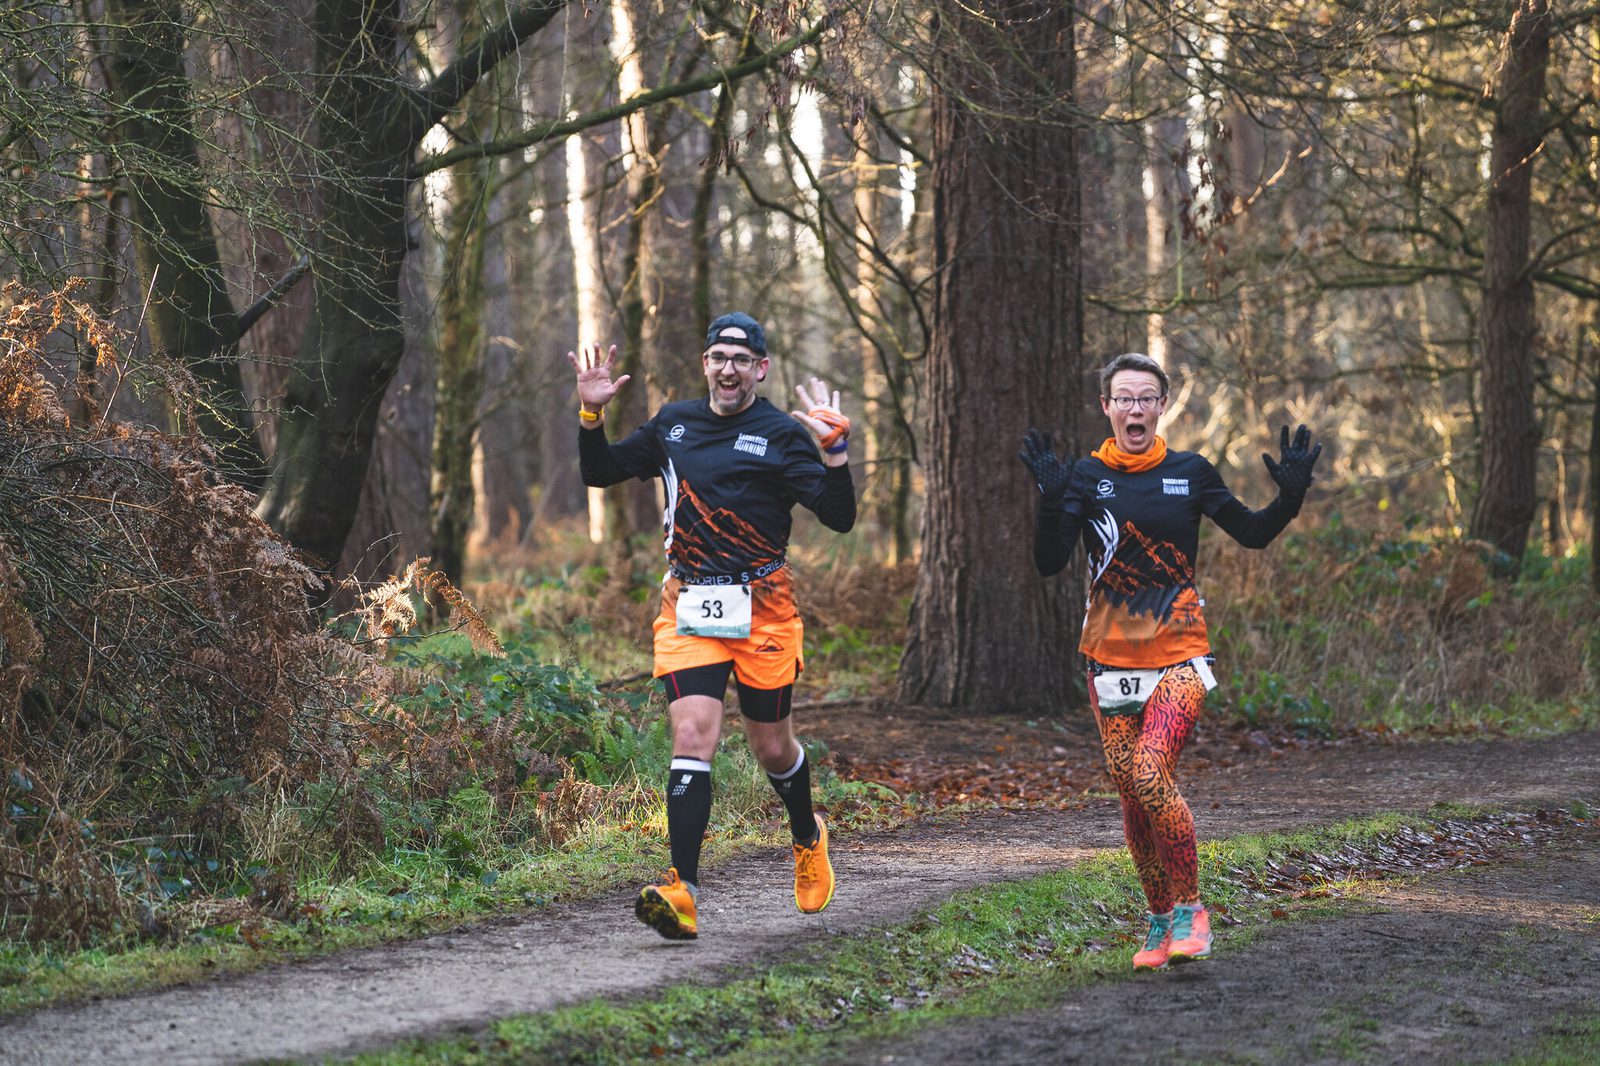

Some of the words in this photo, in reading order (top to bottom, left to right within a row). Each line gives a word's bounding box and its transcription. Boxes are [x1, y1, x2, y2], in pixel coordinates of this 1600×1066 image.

[733, 440, 767, 456] RUNNING
[1163, 483, 1190, 496] RUNNING
[701, 600, 724, 619] 53
[1119, 677, 1142, 696] 87
